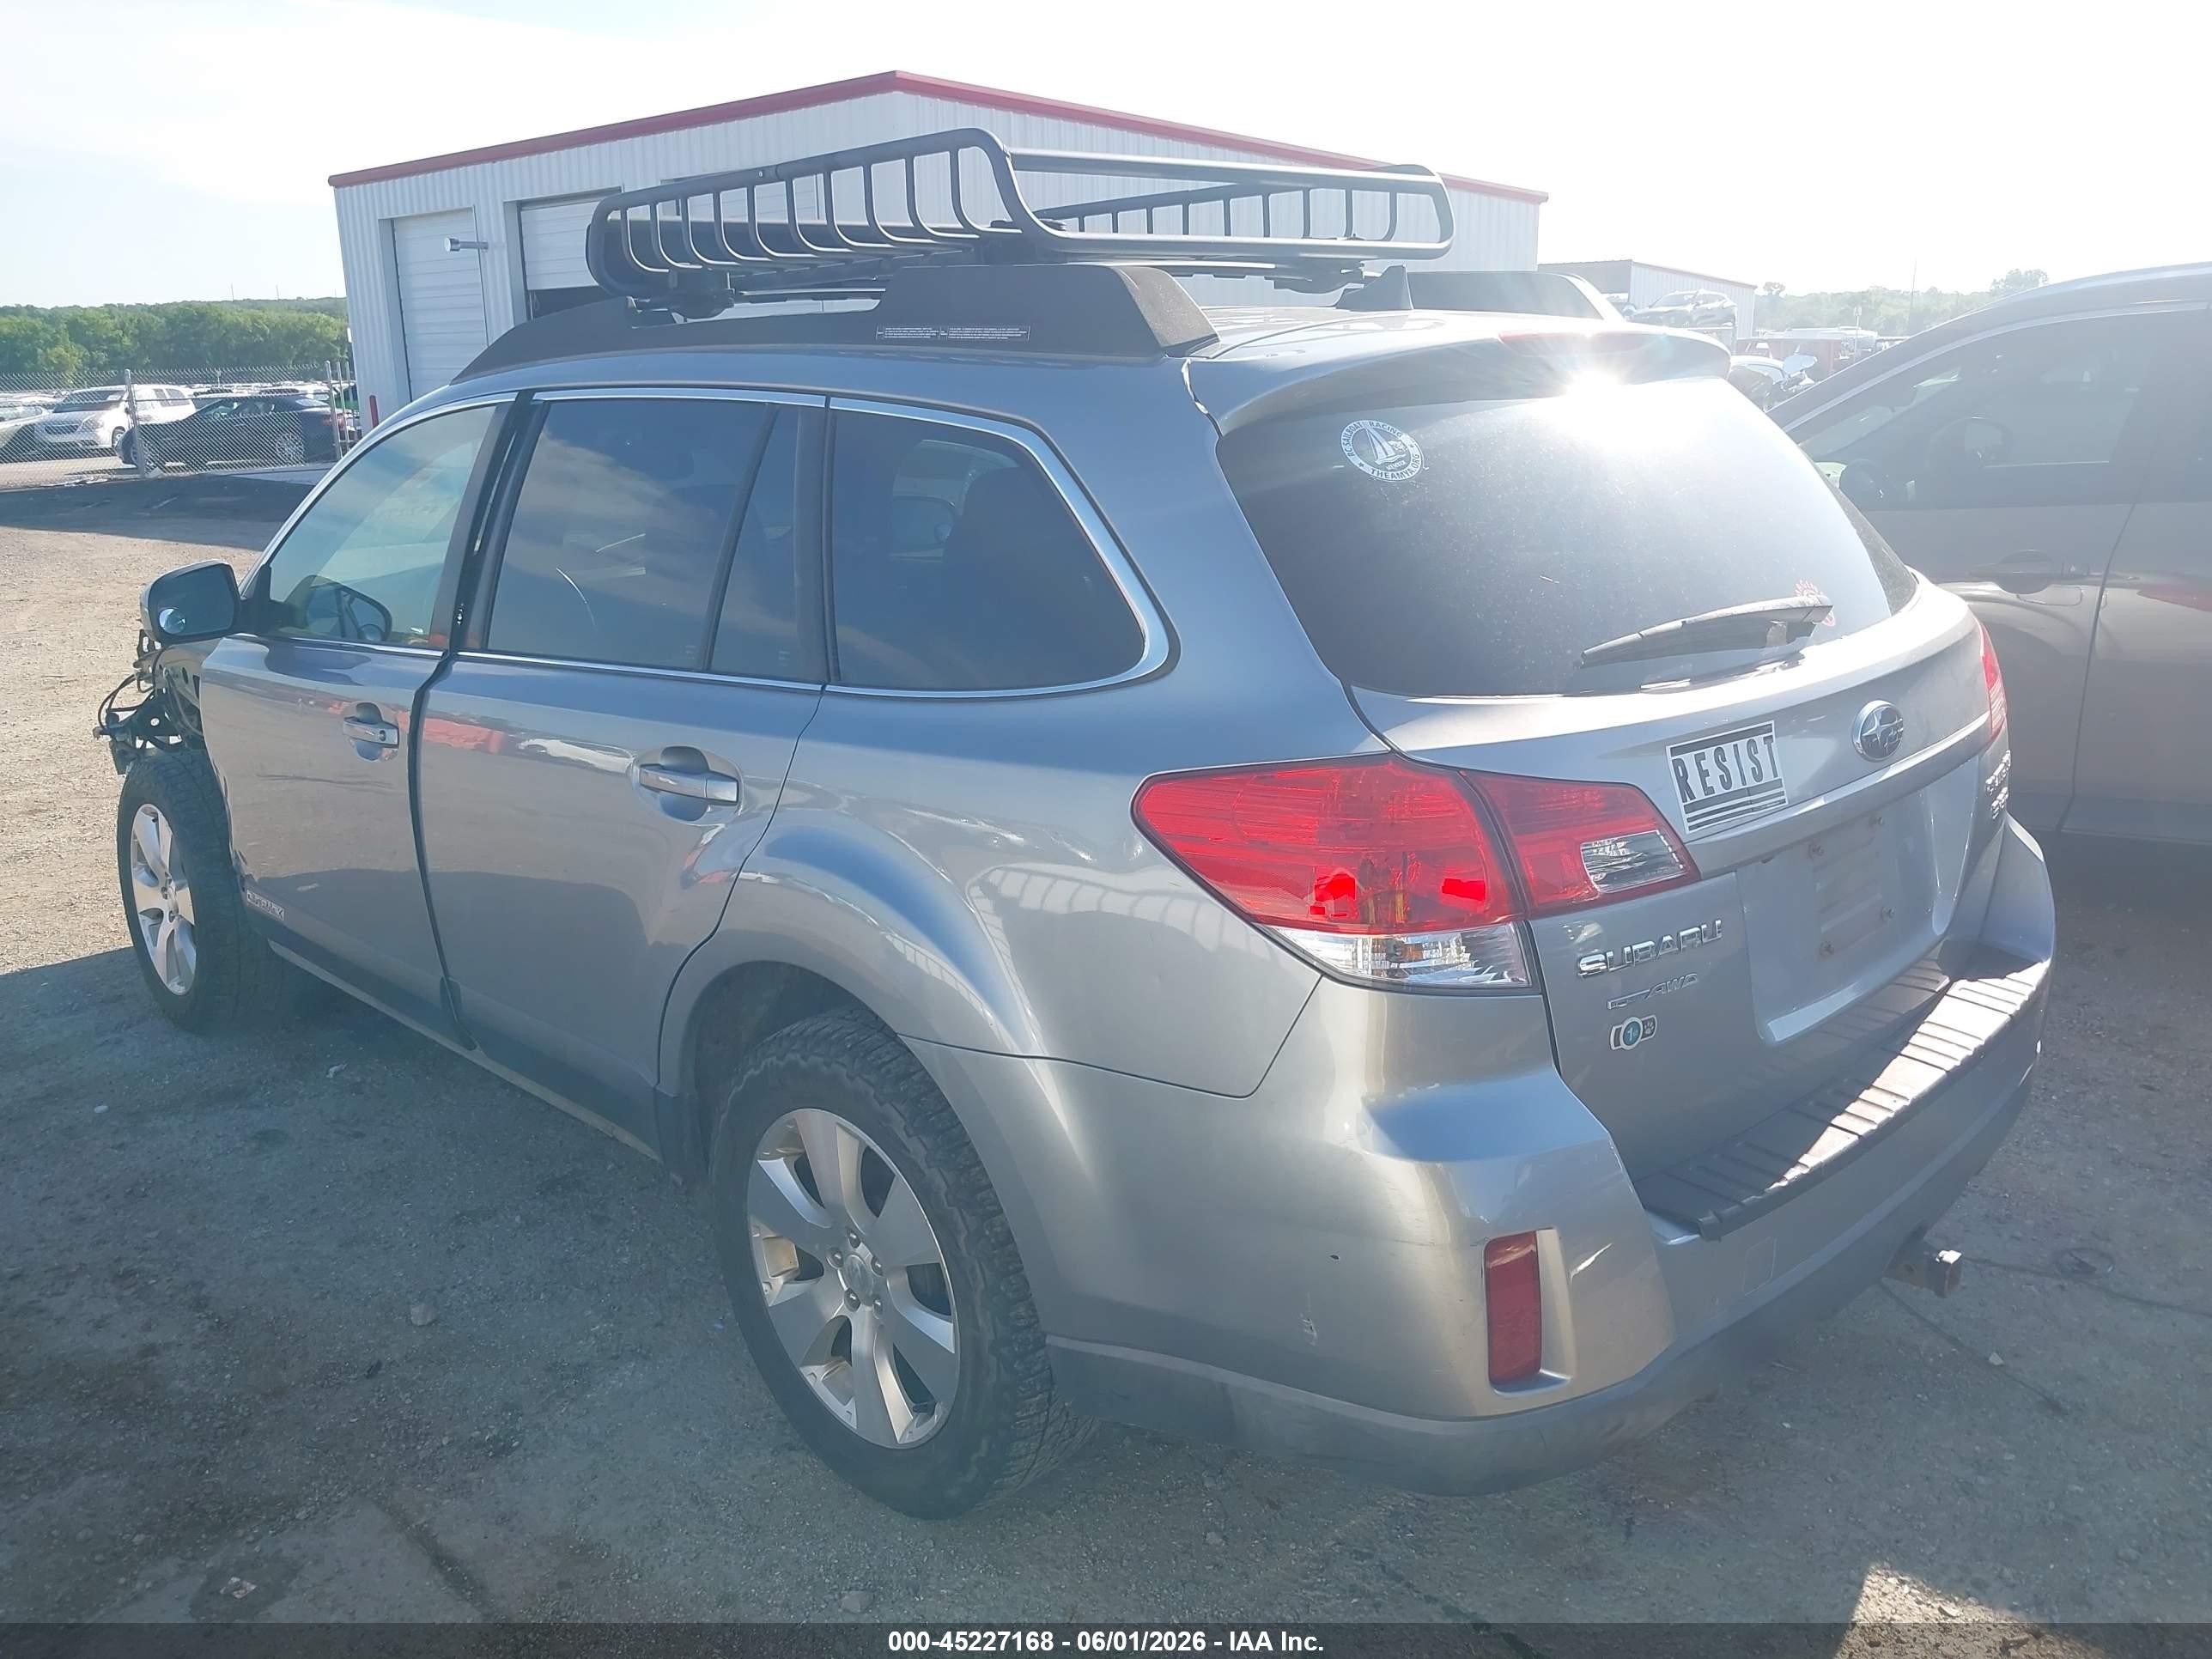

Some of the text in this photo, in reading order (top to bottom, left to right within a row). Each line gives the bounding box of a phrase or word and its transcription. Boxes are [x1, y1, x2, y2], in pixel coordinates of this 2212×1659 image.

[1342, 421, 1403, 457] RC SAILBOAT RACING
[1370, 453, 1420, 479] THEAMYA.ORG
[1672, 735, 1778, 803] RESIST
[1577, 919, 1723, 979] SUBARU
[1644, 973, 1699, 1000] AWD
